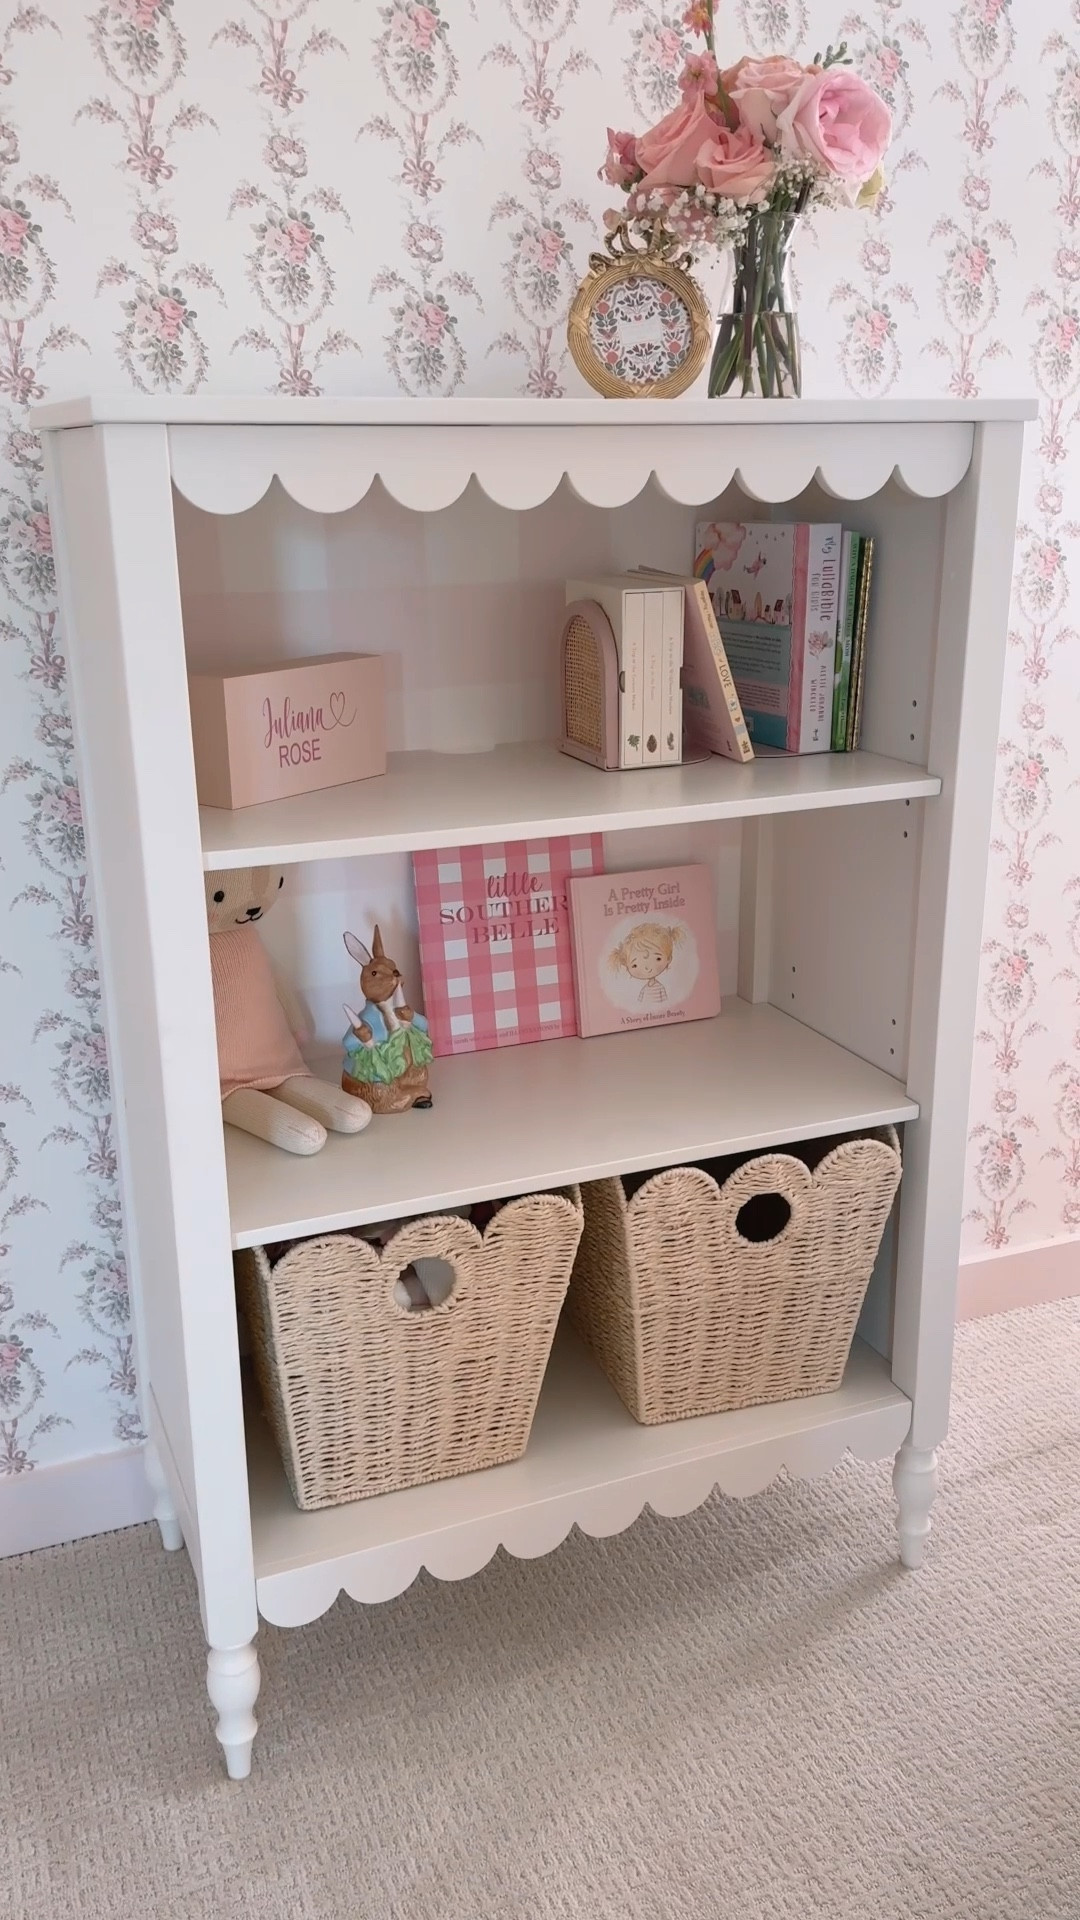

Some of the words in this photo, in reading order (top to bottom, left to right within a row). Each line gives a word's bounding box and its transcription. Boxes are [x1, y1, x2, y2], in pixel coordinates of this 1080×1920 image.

[719, 664, 733, 689] LOVE
[262, 696, 330, 749] Juliana
[278, 738, 322, 768] ROSE
[487, 871, 543, 899] little
[608, 888, 618, 902] A
[621, 886, 655, 901] Pretty
[657, 882, 681, 896] Girl
[439, 895, 569, 926] SOUTHER
[603, 904, 614, 917] Is
[616, 902, 651, 914] Pretty
[653, 896, 686, 910] Inside
[472, 917, 560, 944] BELLE
